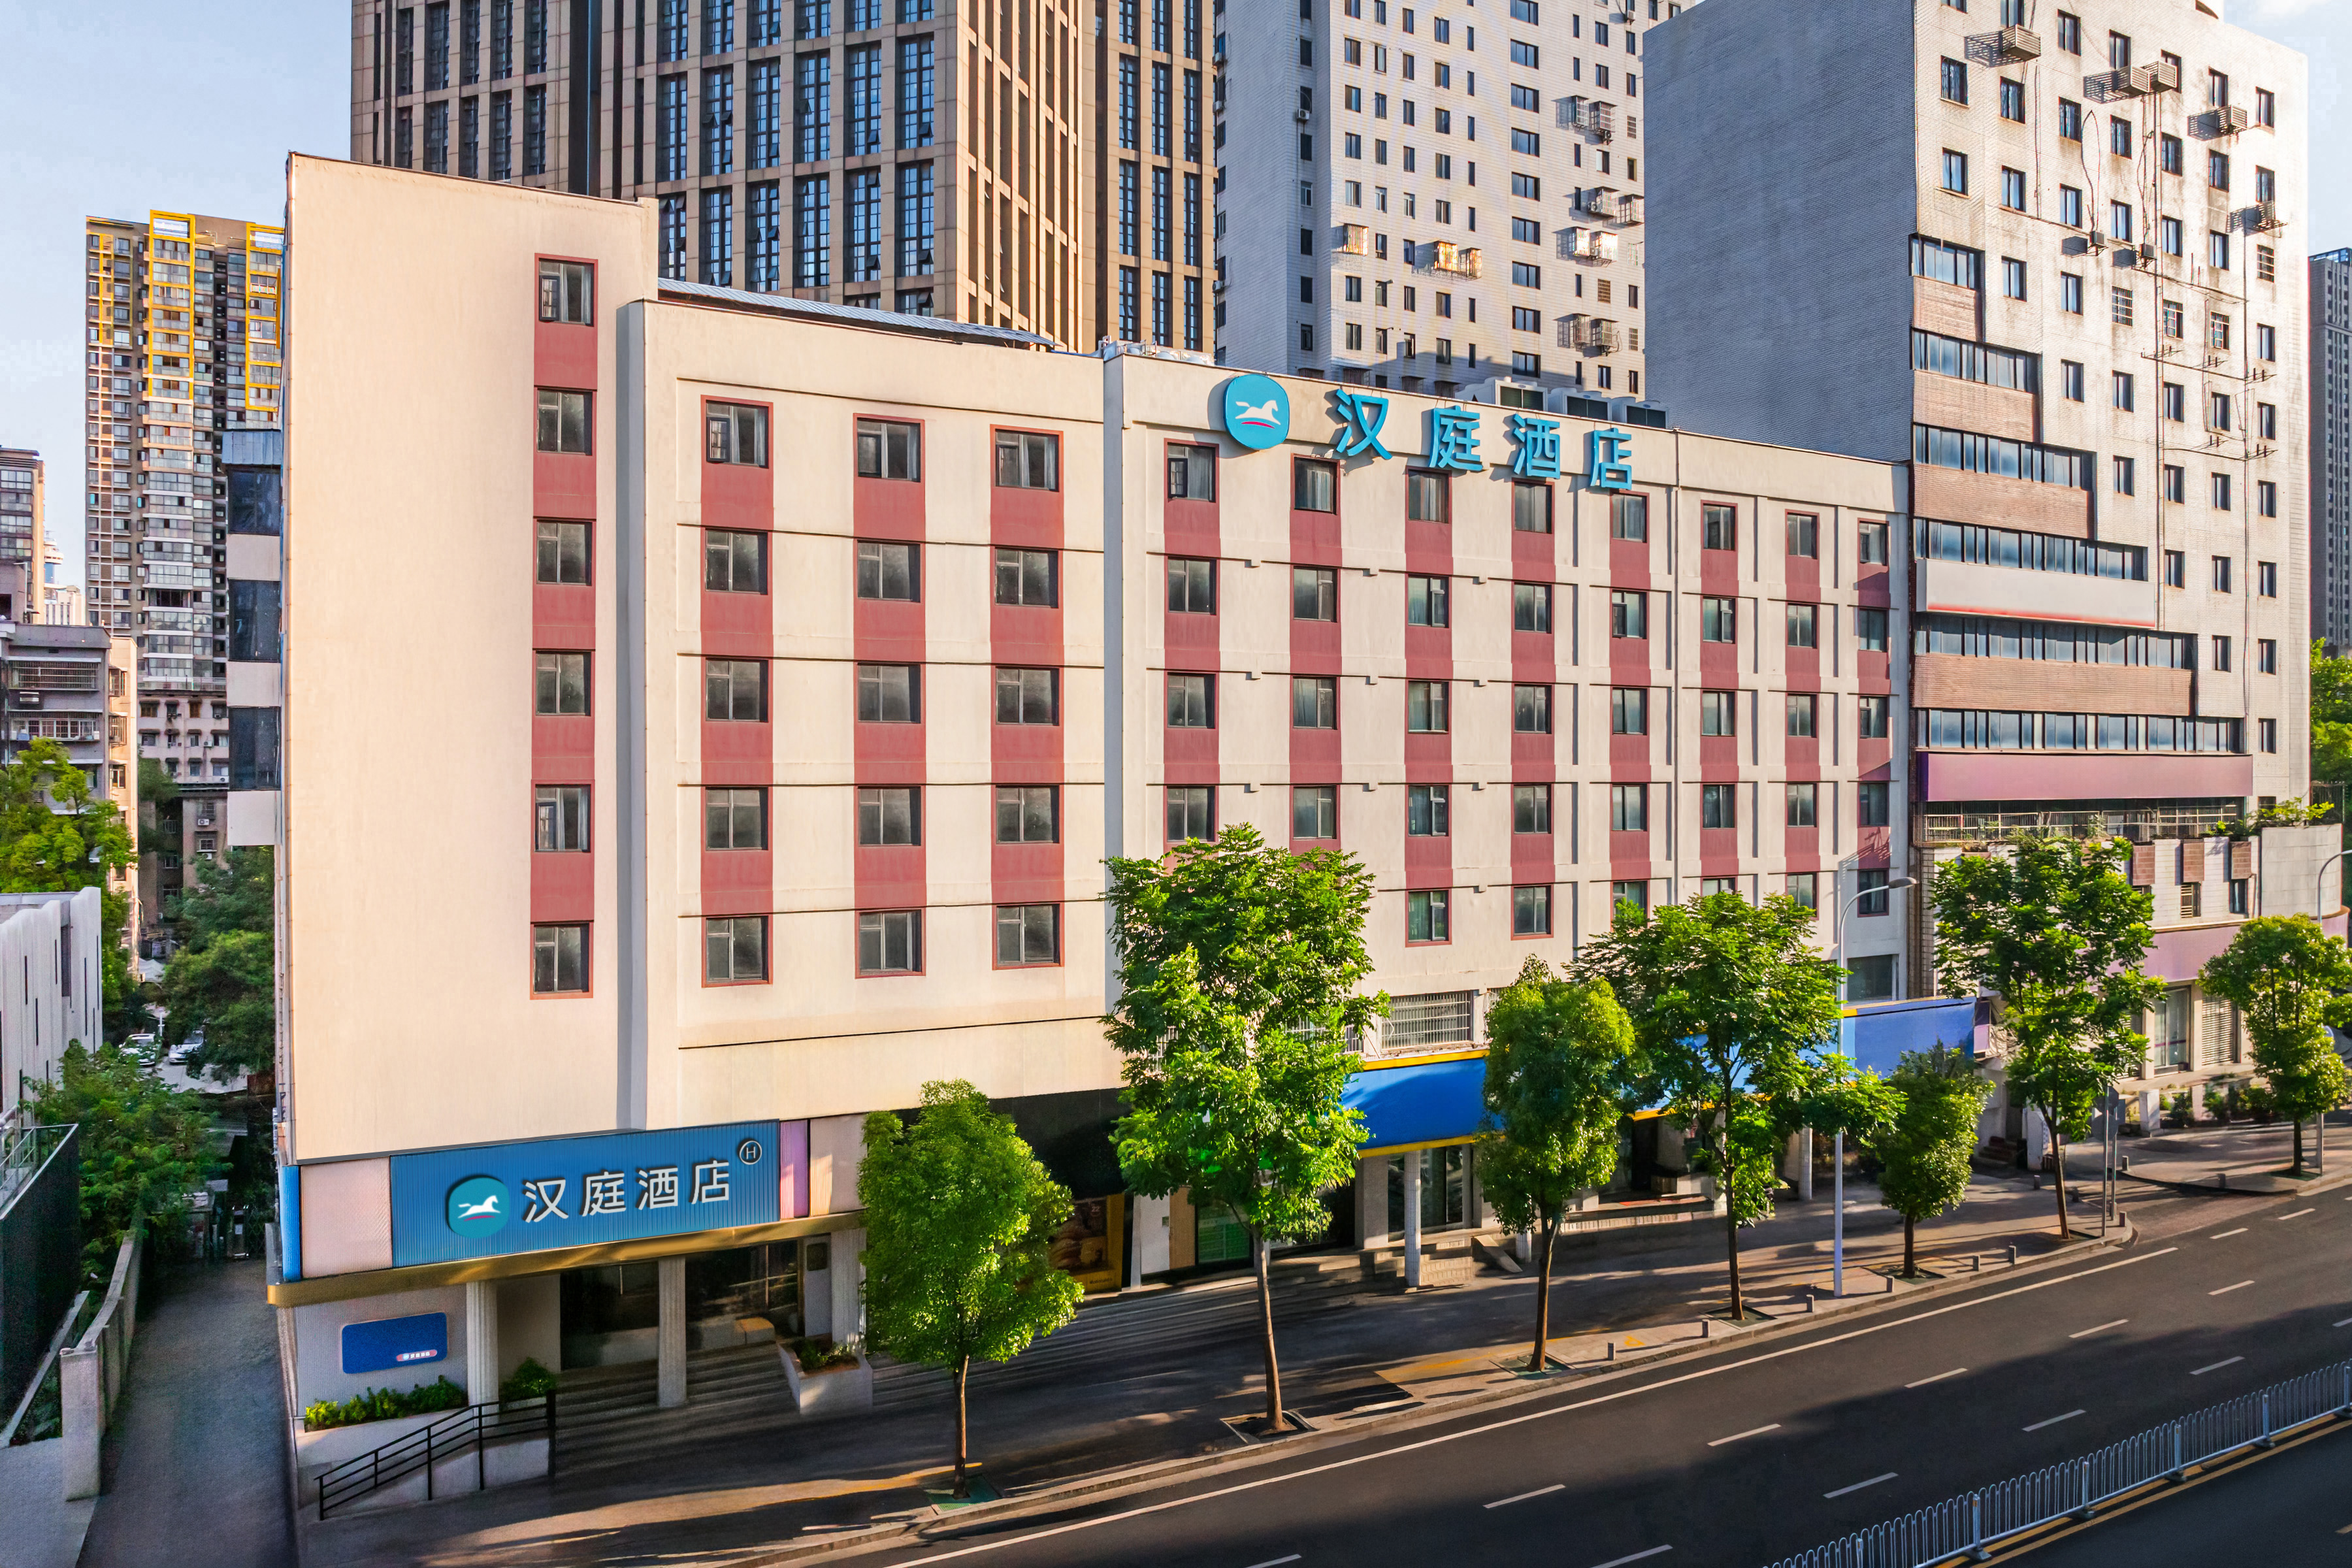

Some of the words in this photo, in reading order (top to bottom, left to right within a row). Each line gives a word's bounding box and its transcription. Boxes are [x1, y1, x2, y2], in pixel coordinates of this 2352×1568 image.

[1335, 389, 1632, 490] 汉庭酒店
[525, 1160, 729, 1223] 汉庭酒店
